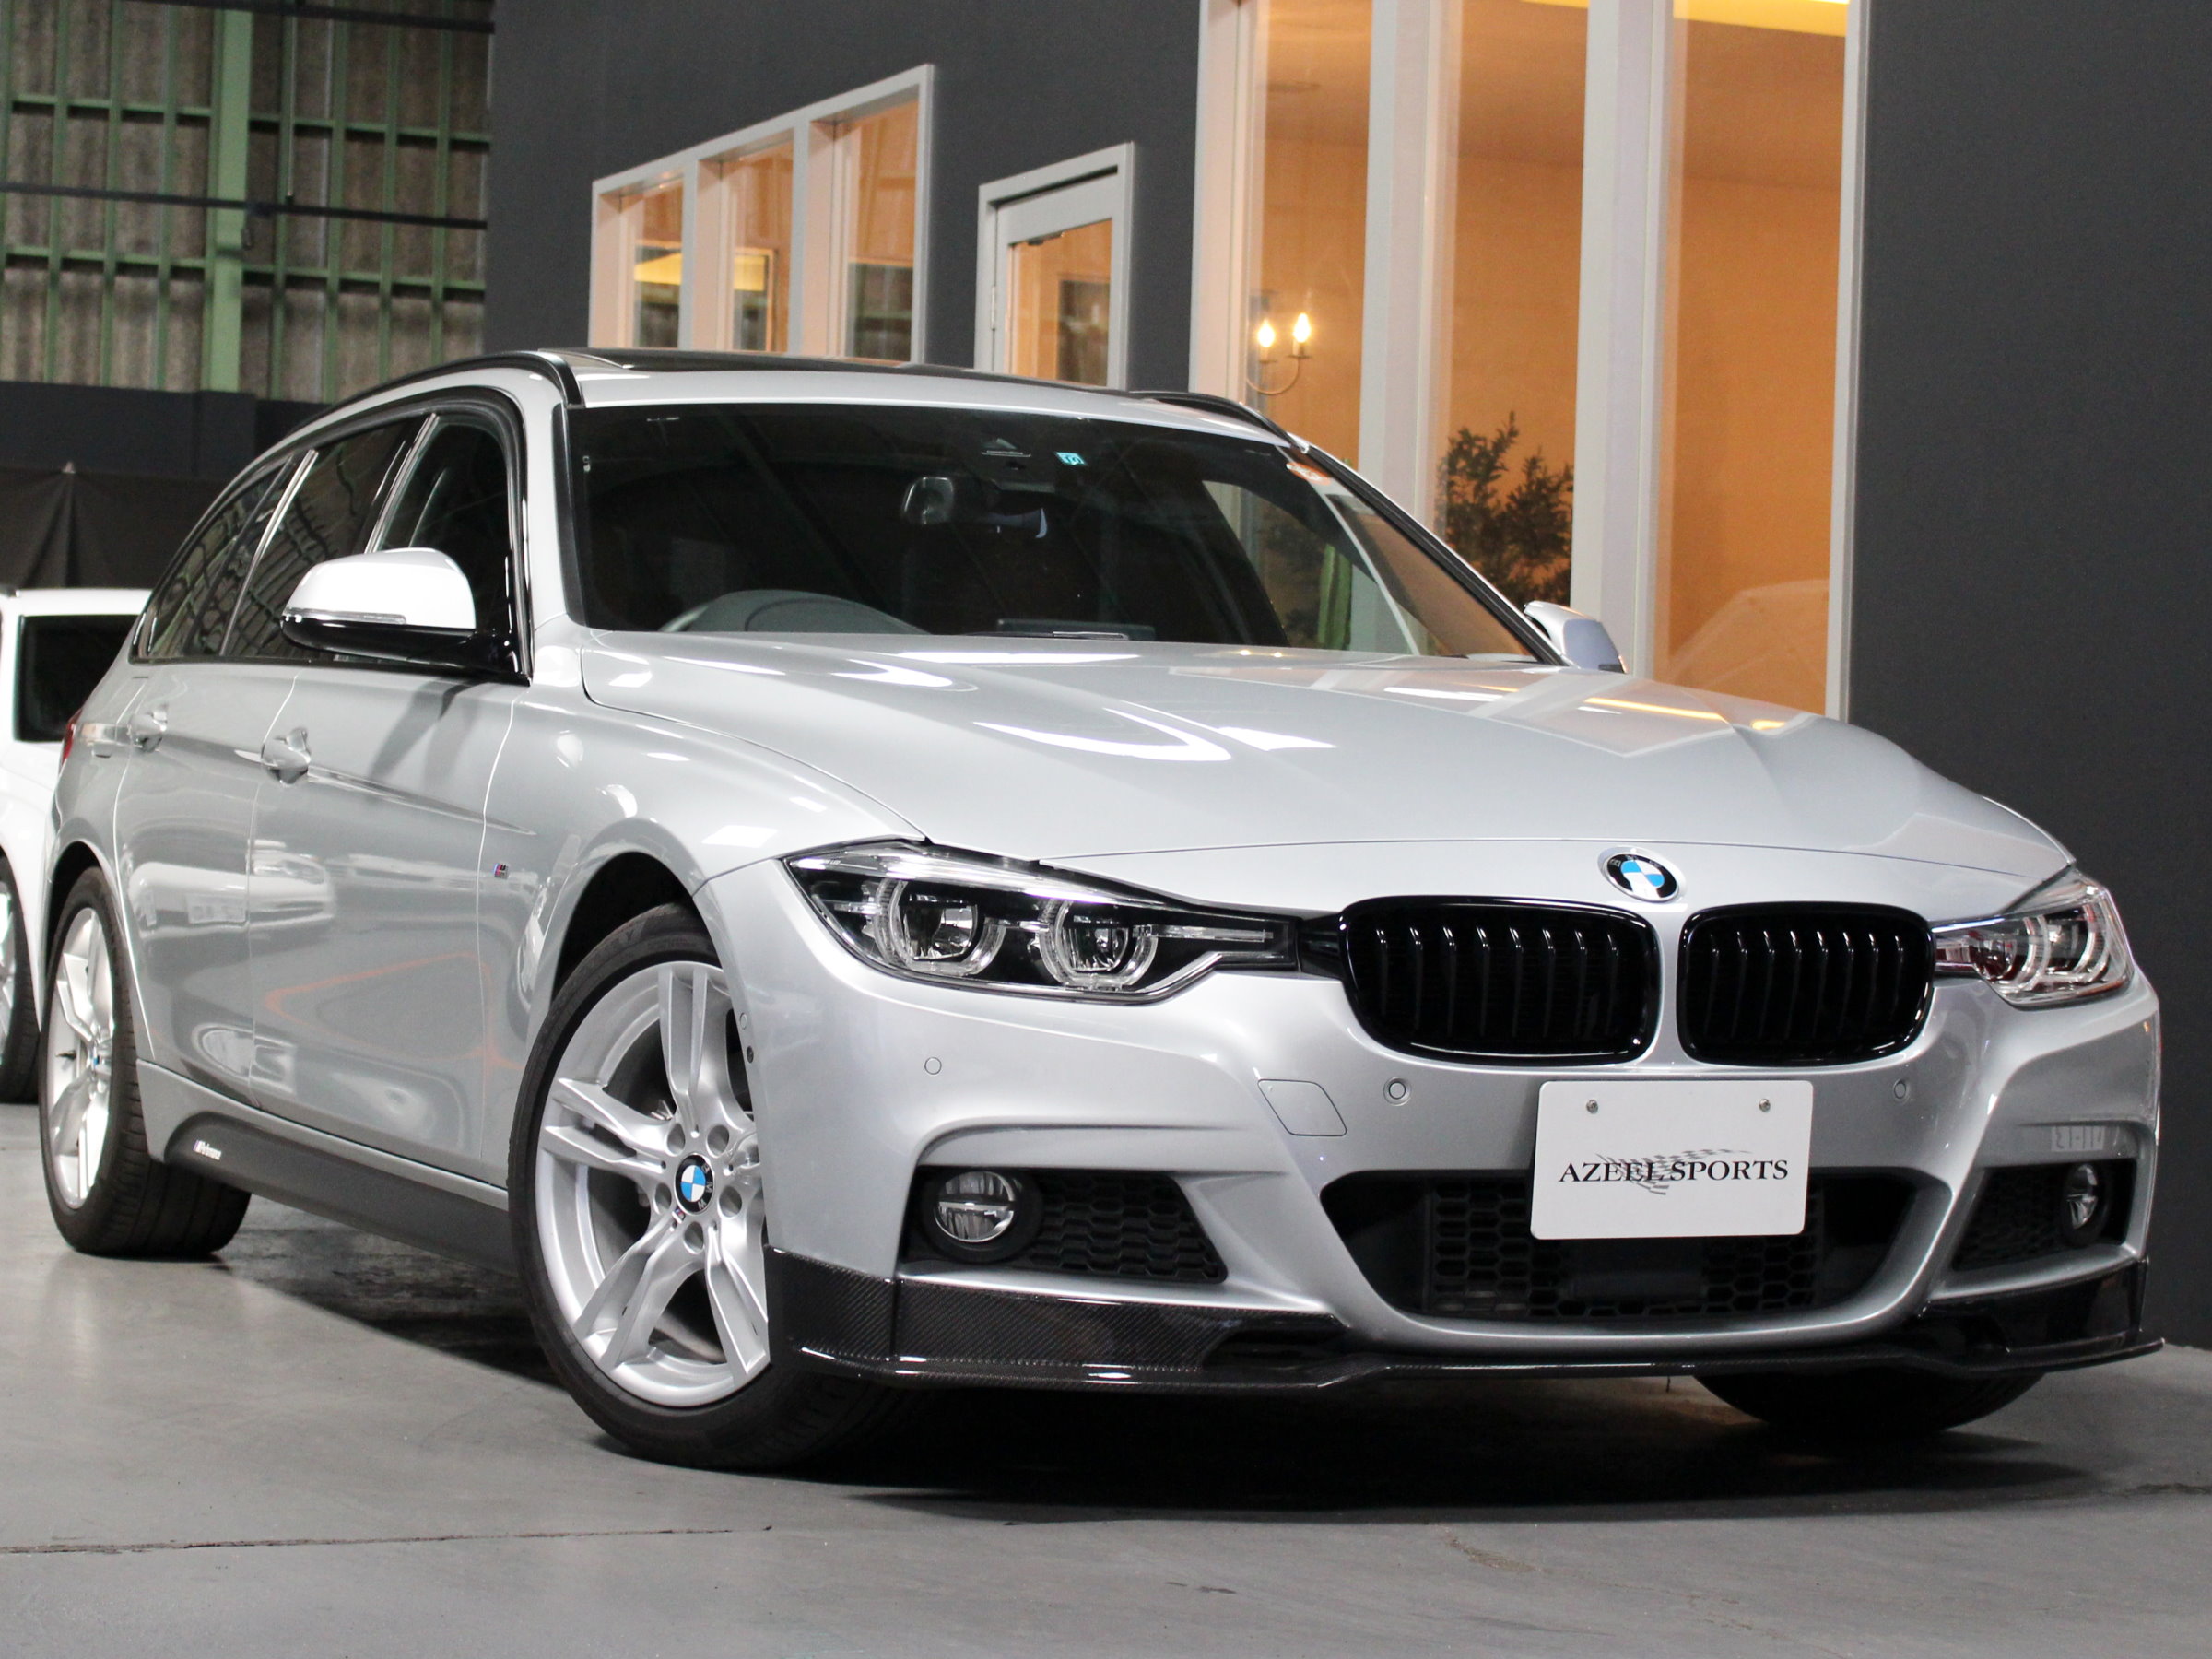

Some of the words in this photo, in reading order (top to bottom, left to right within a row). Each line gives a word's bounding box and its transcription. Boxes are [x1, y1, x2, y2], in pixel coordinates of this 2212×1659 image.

[697, 1163, 713, 1210] BMW
[1558, 1161, 1664, 1182] AZEEL
[1669, 1159, 1788, 1181] SPORTS
